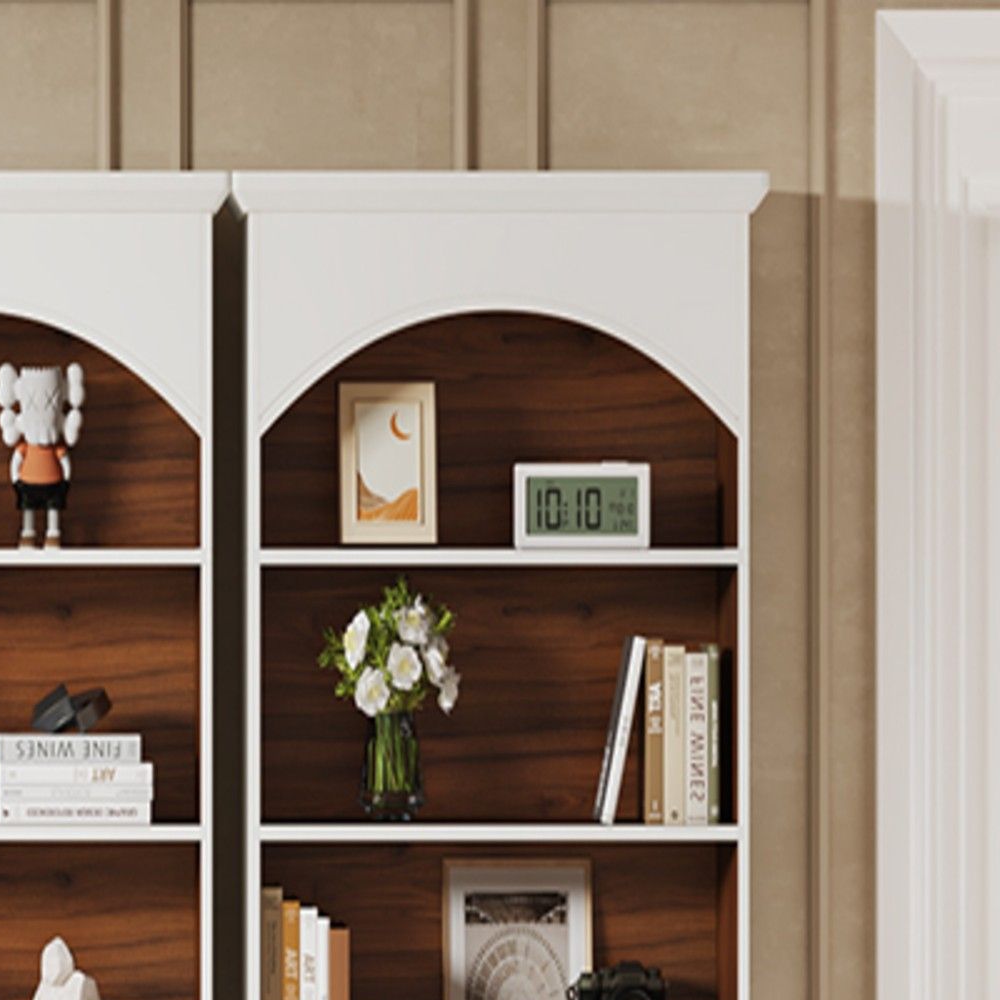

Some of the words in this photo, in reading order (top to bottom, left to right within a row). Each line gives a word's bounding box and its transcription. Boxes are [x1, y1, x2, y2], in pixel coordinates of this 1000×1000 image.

[536, 487, 601, 530] 10:10
[16, 740, 74, 758] WINES
[85, 740, 121, 758] FINE
[92, 768, 116, 782] ART
